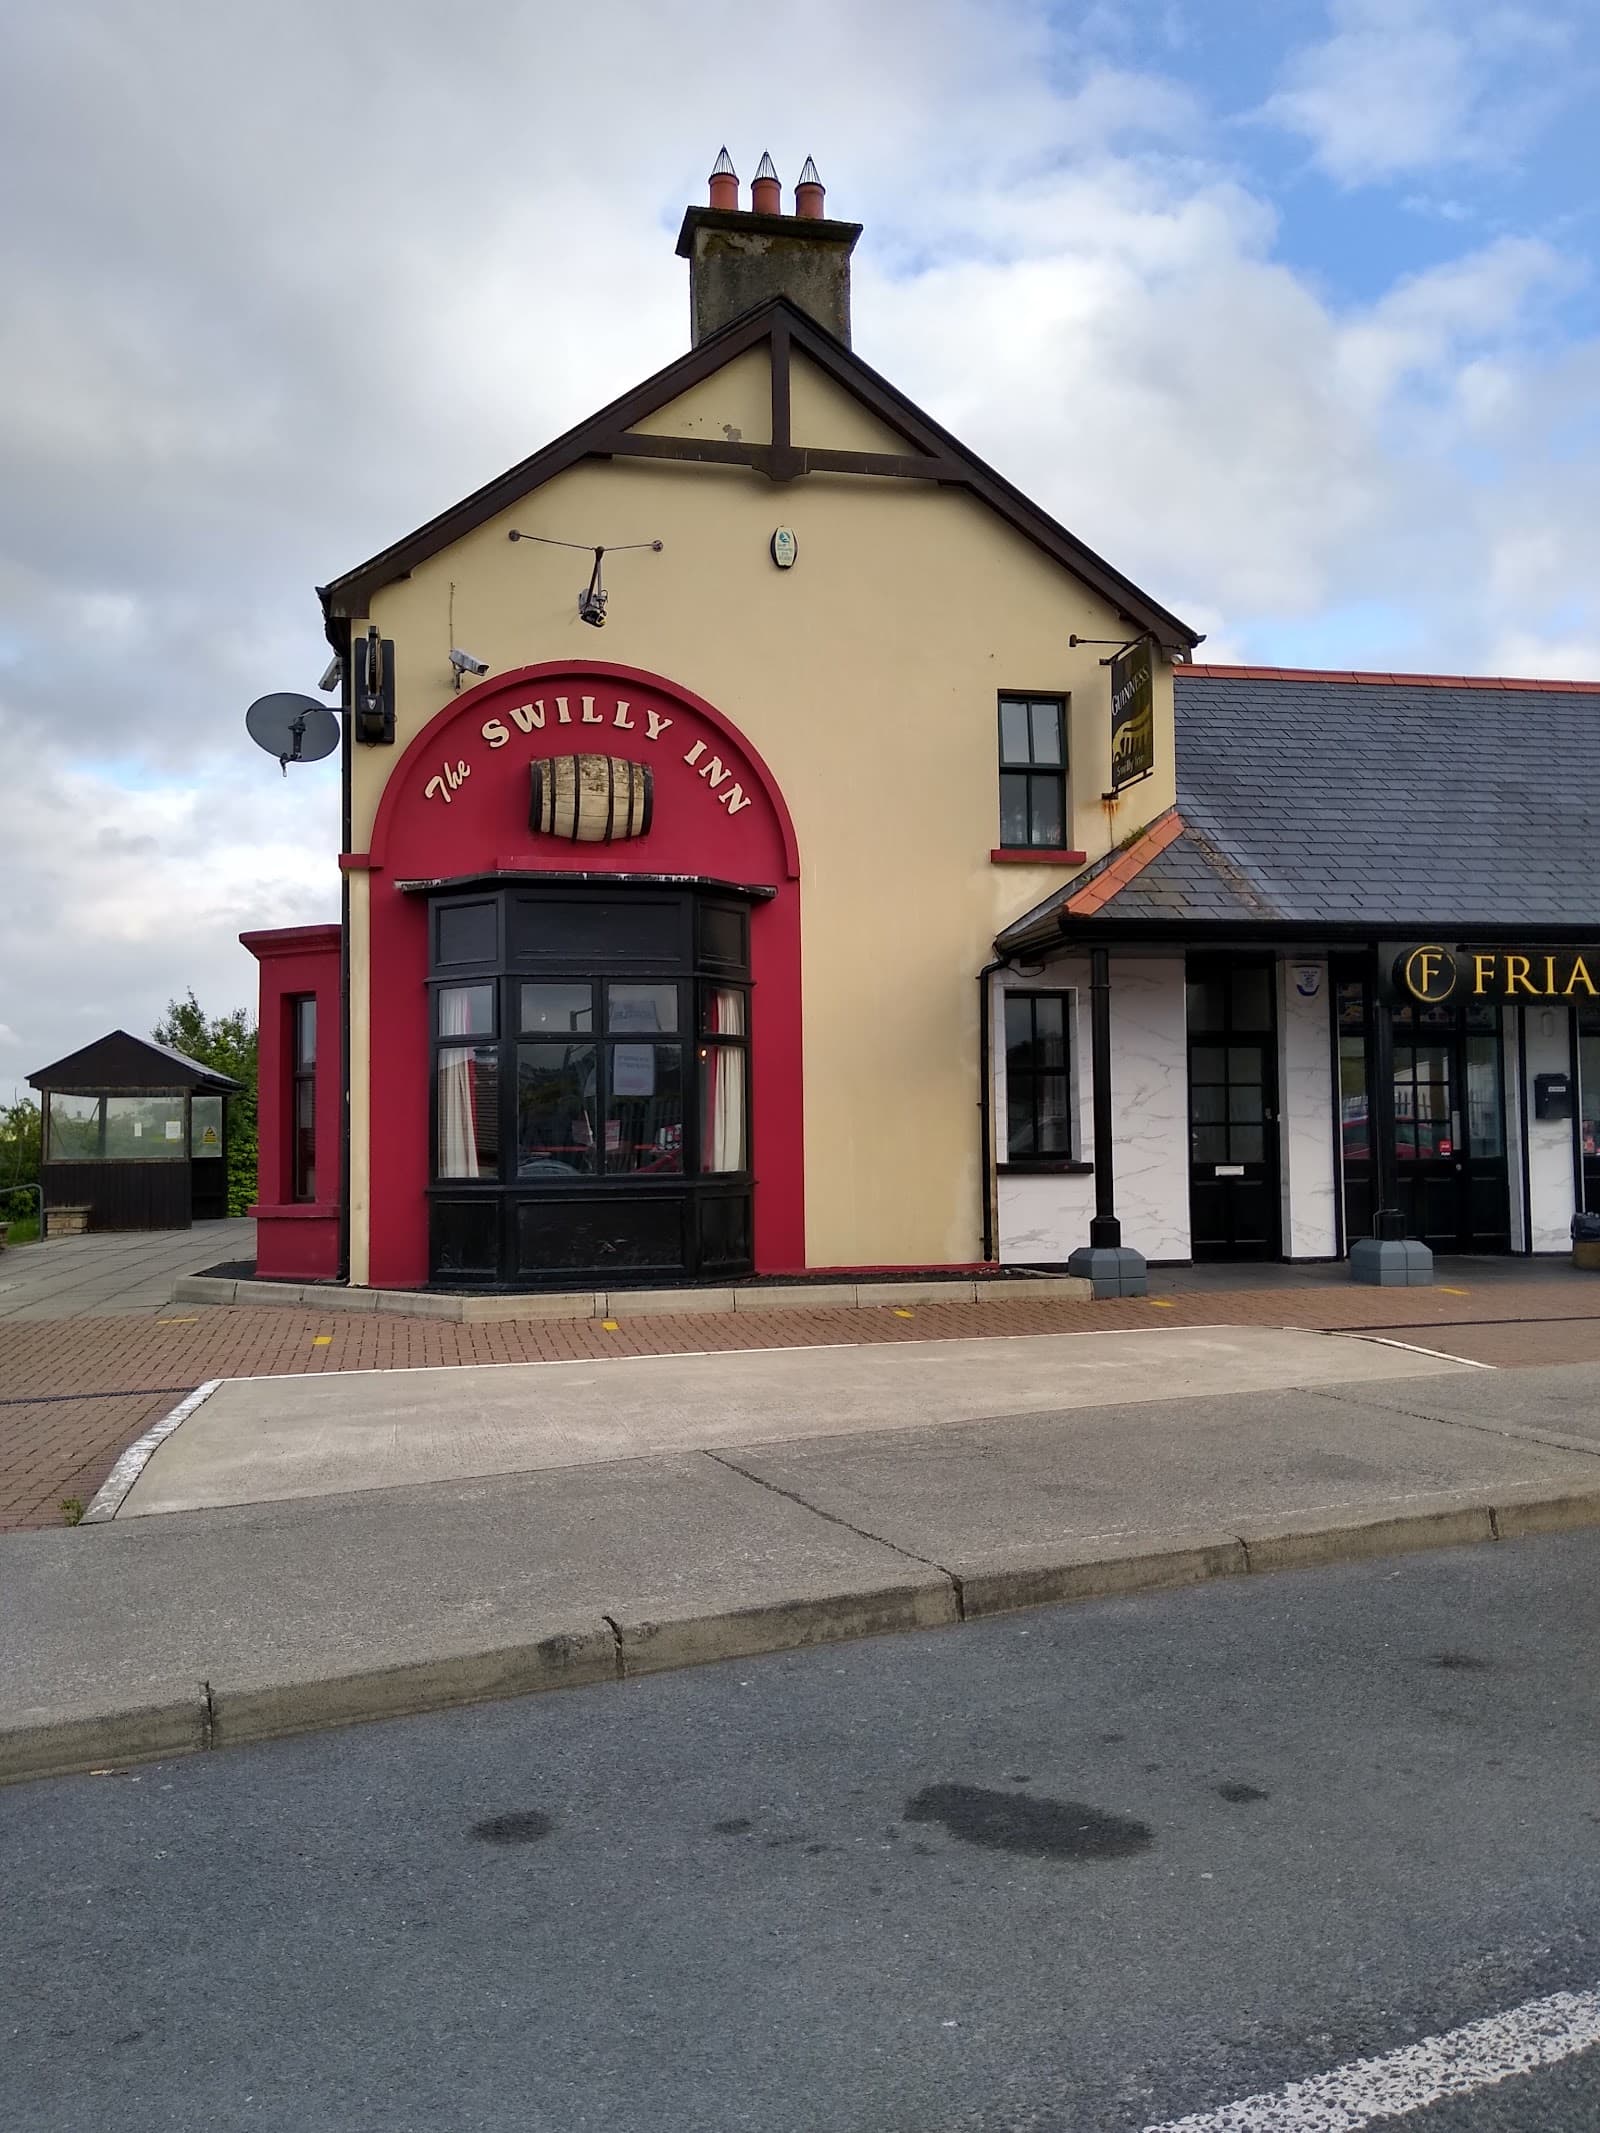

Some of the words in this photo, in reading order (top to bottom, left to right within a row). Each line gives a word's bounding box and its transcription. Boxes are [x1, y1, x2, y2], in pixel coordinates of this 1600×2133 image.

[1111, 665, 1150, 716] GUINNESS
[424, 759, 471, 803] The
[481, 696, 672, 748] SWILLY
[682, 740, 751, 816] INN
